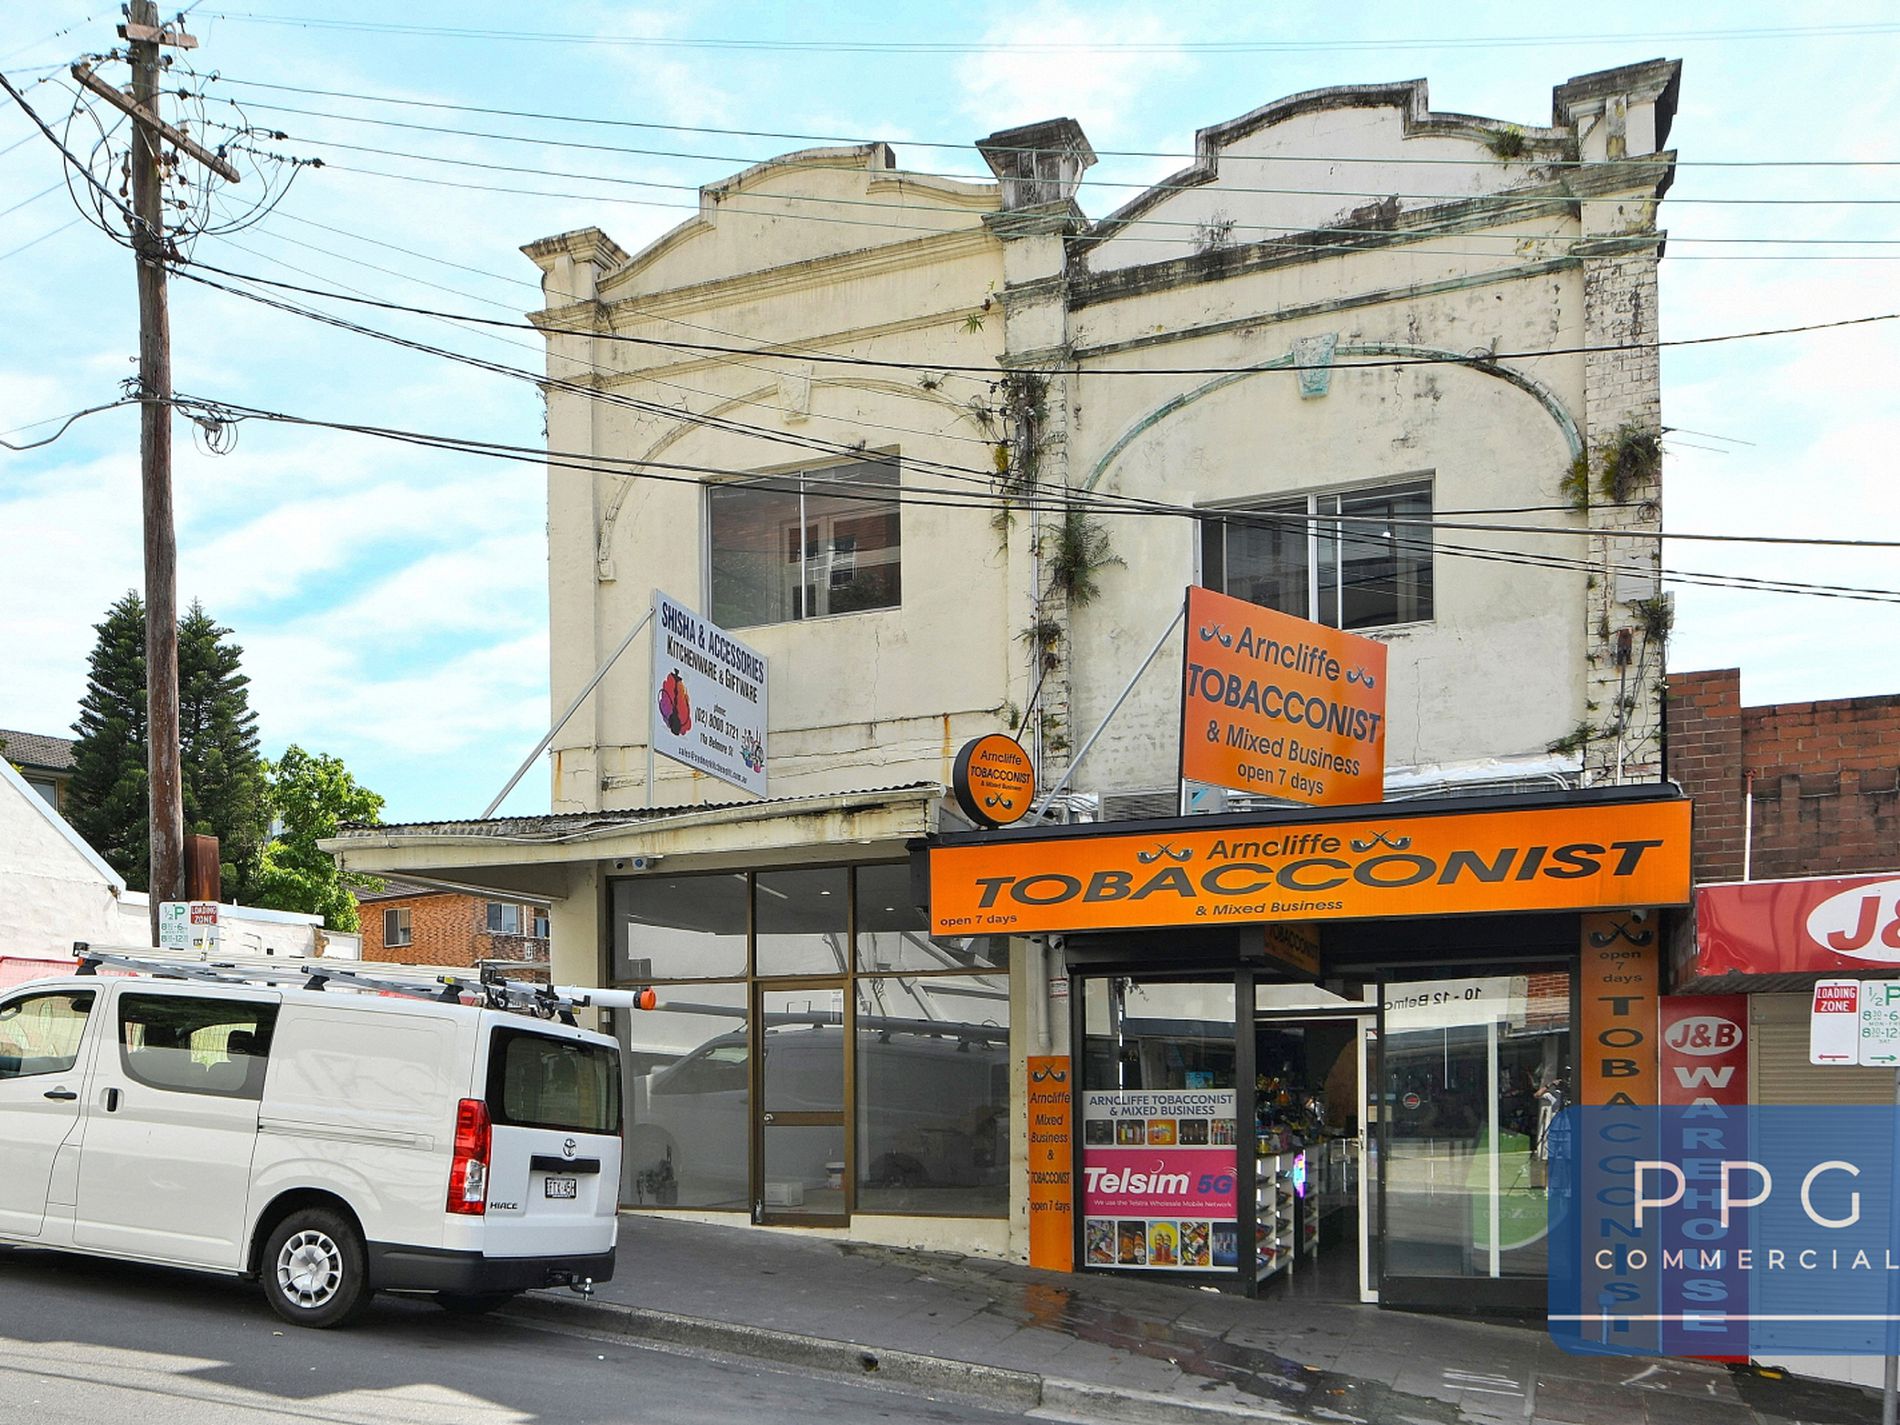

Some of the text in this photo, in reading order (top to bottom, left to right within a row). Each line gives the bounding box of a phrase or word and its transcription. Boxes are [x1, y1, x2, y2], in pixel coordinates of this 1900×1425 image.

[662, 602, 764, 684] SHISHA & ACCESSORIES
[1235, 627, 1340, 681] Arncliffe
[719, 670, 724, 685] &
[1189, 663, 1381, 743] TOBACCONIST
[1207, 720, 1360, 776] & Mixed Business
[980, 750, 1022, 765] Arncliffe
[971, 766, 1030, 784] TOBACCONIST
[1238, 762, 1324, 796] open 7 days
[1206, 834, 1341, 860] Arncliffe
[976, 840, 1664, 908] TOBACCONIST
[1196, 899, 1343, 916] & Mixed Business
[194, 916, 214, 924] ZONE
[940, 913, 1018, 927] open 7 days
[1600, 952, 1641, 964] open
[1616, 962, 1625, 970] 7
[1603, 973, 1642, 984] days
[1817, 987, 1856, 999] LOADING
[1821, 1001, 1850, 1012] ZONE
[1672, 1024, 1736, 1048] J&B
[1030, 1093, 1071, 1104] Arncliffe
[1089, 1095, 1233, 1105] ARNCLIFFE TOBACCONIST
[1110, 1106, 1215, 1116] & MIXED BUSINESS
[1035, 1114, 1063, 1126] Mixed
[1031, 1132, 1068, 1143] Business
[1047, 1149, 1054, 1160] &
[1031, 1172, 1071, 1184] TOBACCONIST
[1084, 1160, 1233, 1194] Telsim 5G
[490, 1202, 518, 1210] HIACE
[1031, 1202, 1048, 1212] open
[1055, 1201, 1071, 1213] days
